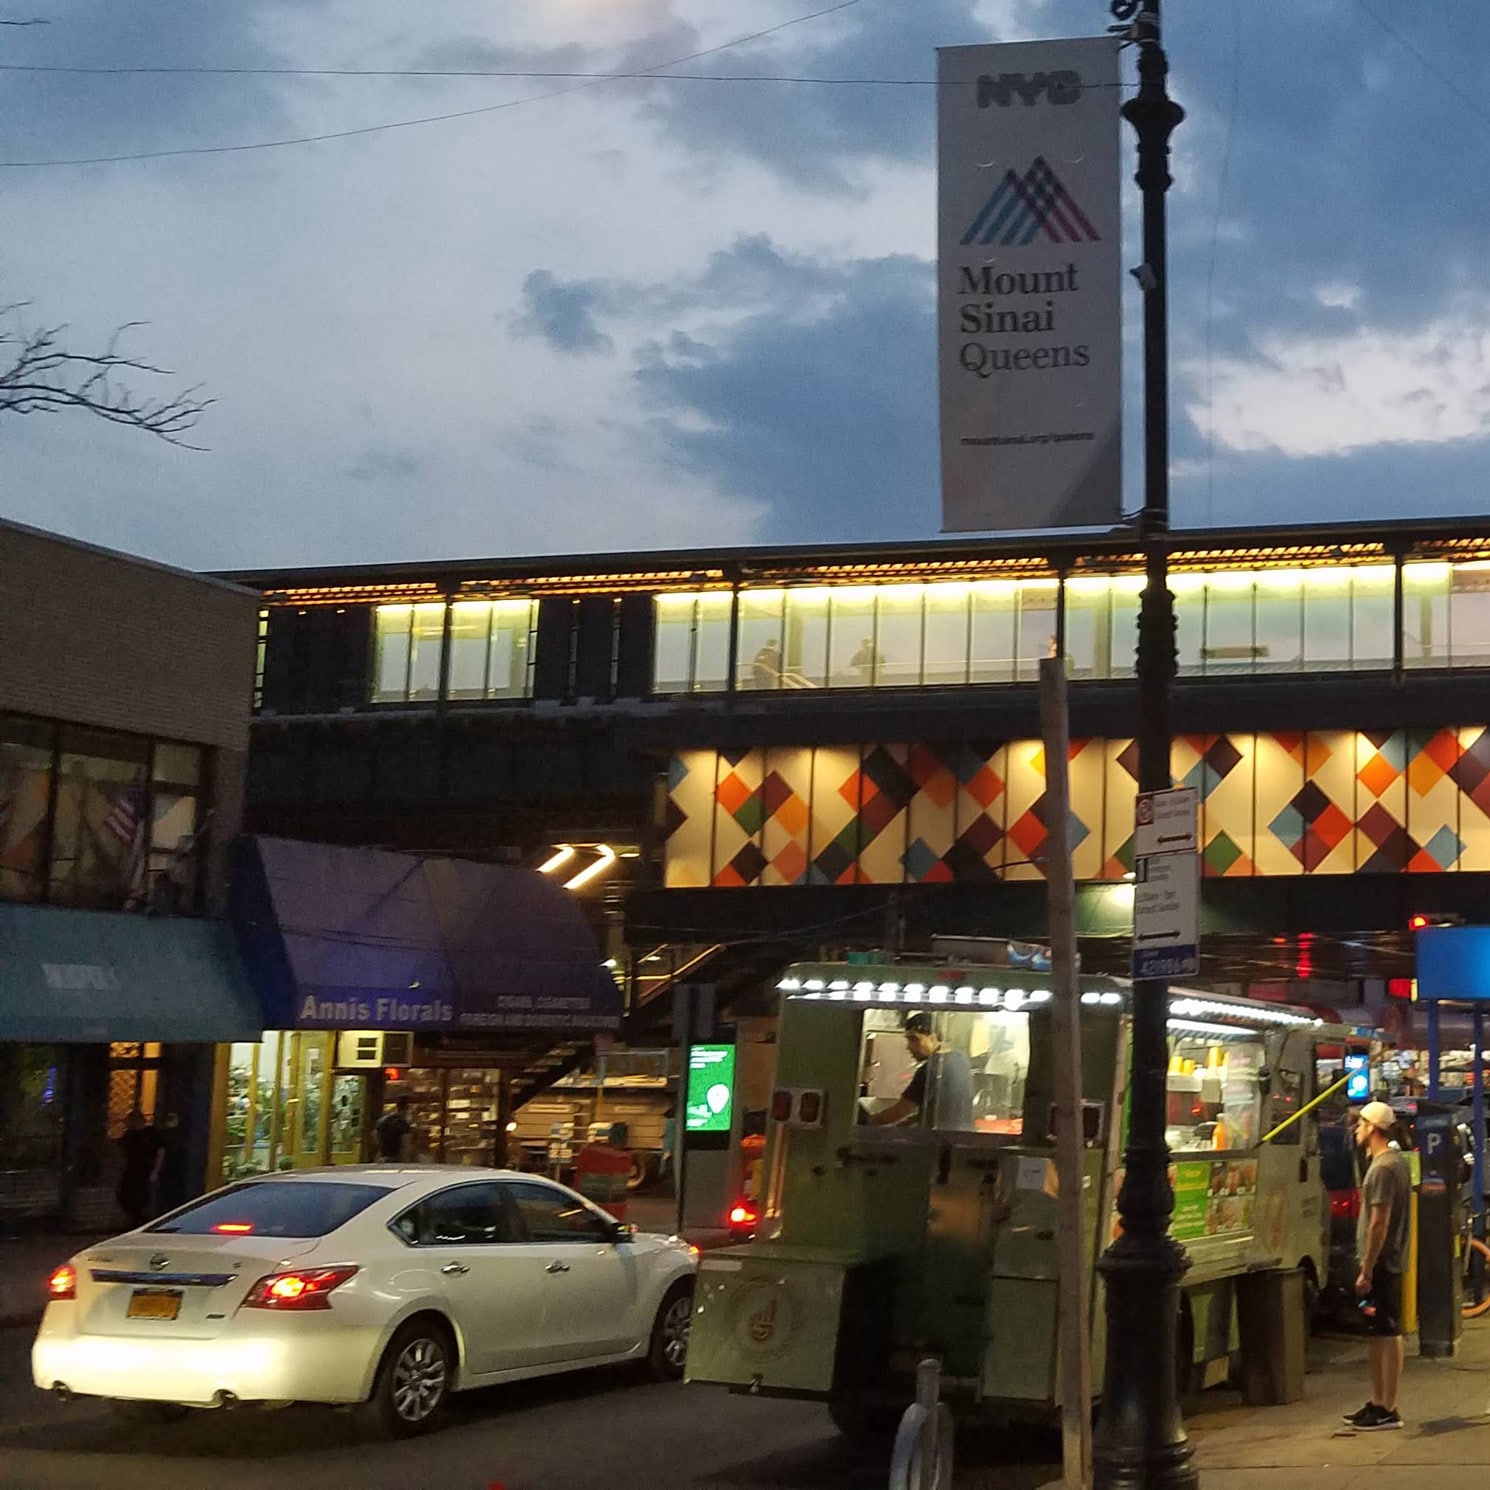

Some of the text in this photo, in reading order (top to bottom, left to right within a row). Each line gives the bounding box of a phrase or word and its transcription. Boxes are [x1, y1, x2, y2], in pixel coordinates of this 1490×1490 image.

[976, 69, 1082, 108] NYC
[957, 262, 1079, 297] Mount
[959, 300, 1056, 334] Sinai
[959, 342, 1091, 379] Queens
[300, 995, 454, 1021] Annis Florals
[1427, 1132, 1442, 1154] P
